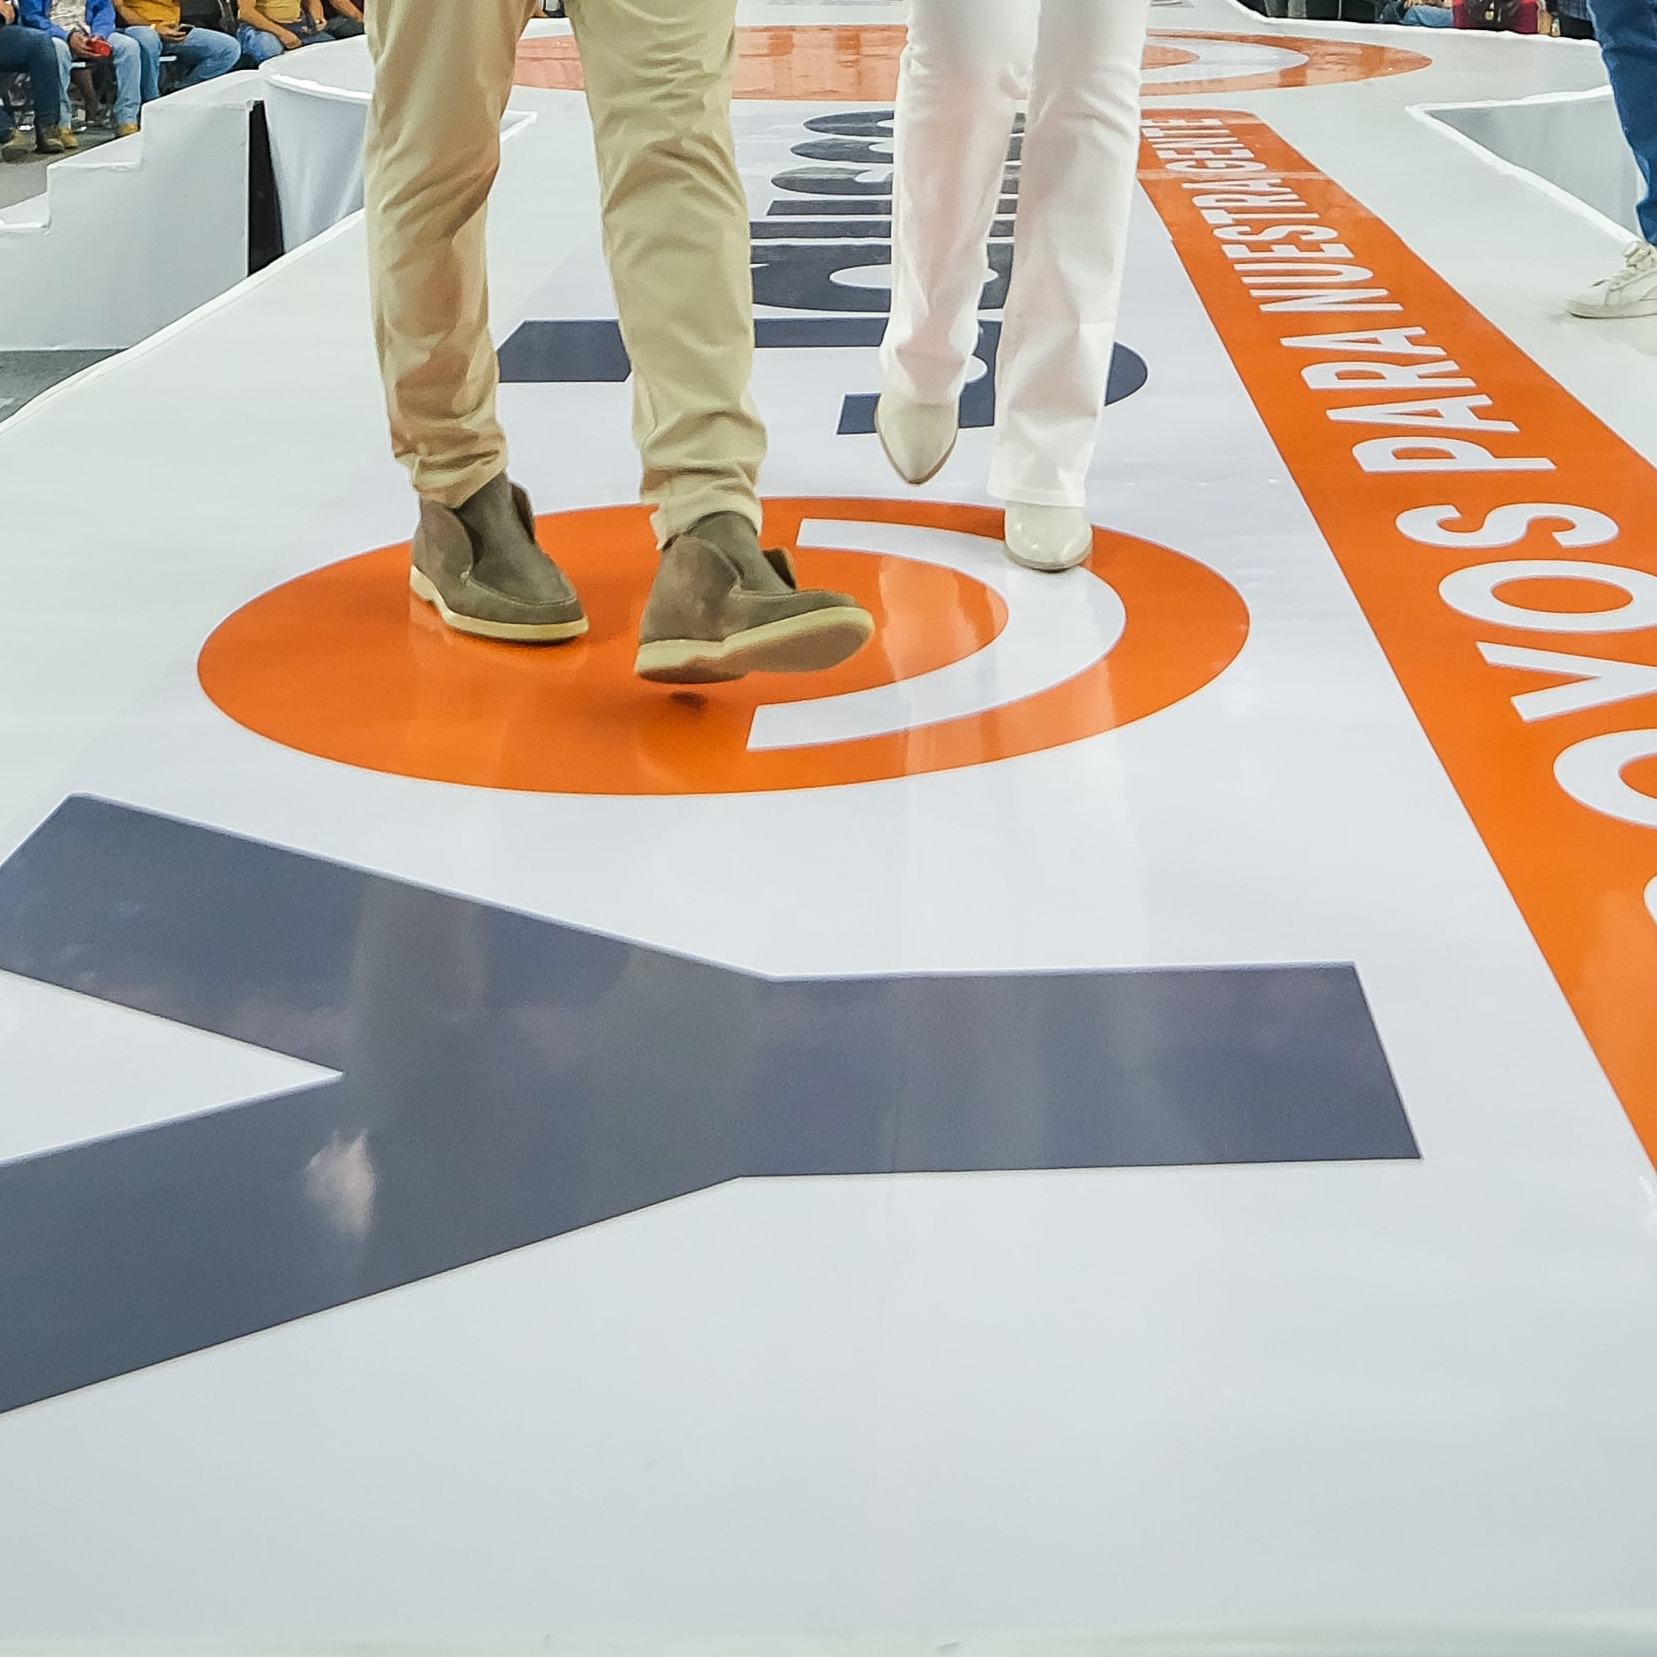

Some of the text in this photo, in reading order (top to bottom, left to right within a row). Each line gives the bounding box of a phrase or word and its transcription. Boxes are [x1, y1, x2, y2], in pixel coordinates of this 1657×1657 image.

[1140, 118, 1266, 173] GENTE
[1181, 178, 1404, 313] NUESTRA
[1280, 329, 1558, 474] PARA
